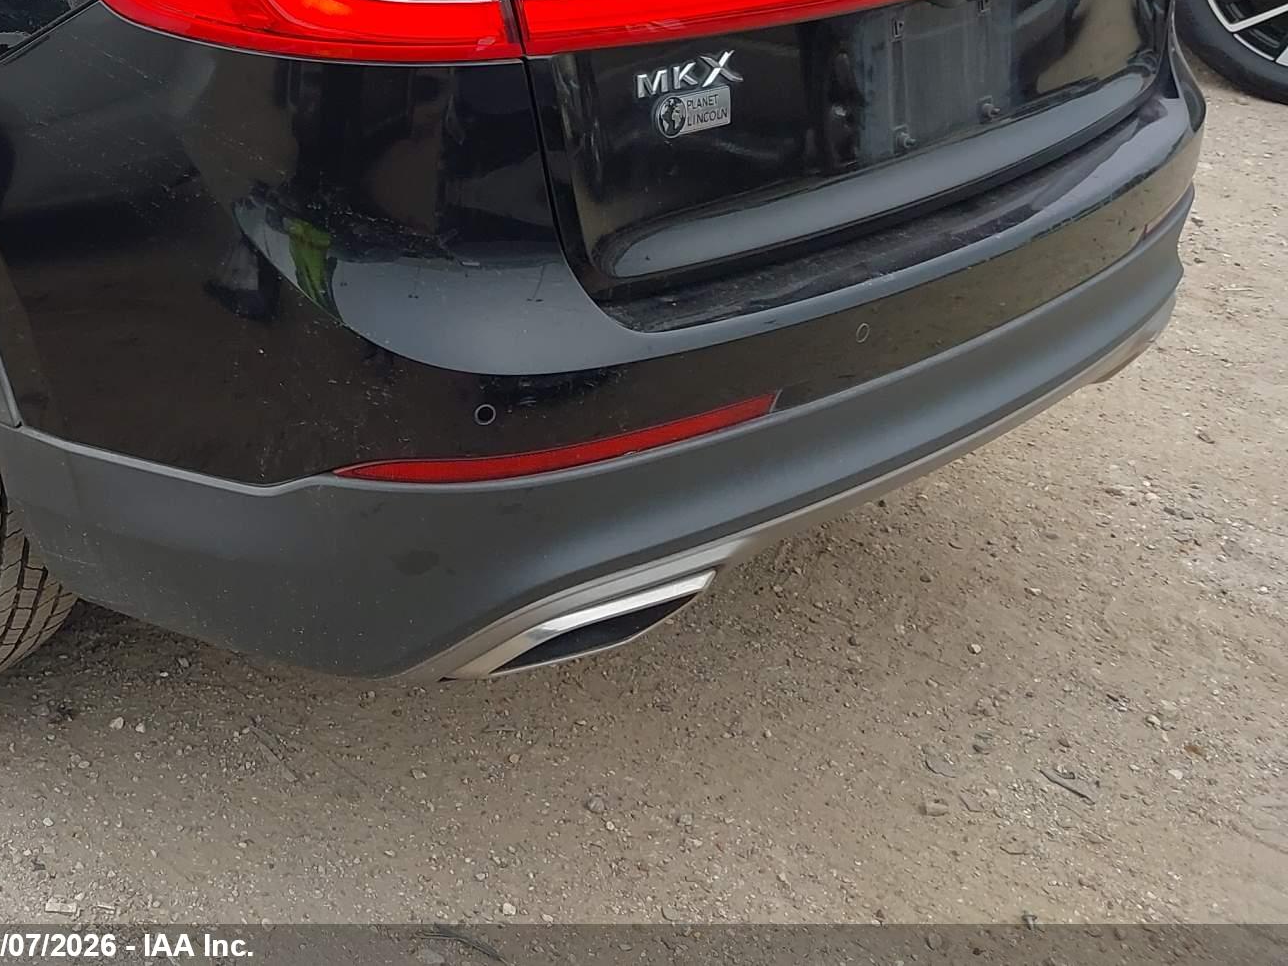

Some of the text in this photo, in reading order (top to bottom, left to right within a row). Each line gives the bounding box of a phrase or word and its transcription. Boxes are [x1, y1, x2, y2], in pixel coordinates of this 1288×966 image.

[636, 49, 744, 99] MKX
[686, 94, 719, 111] PLANET
[686, 107, 729, 127] LINCOLN
